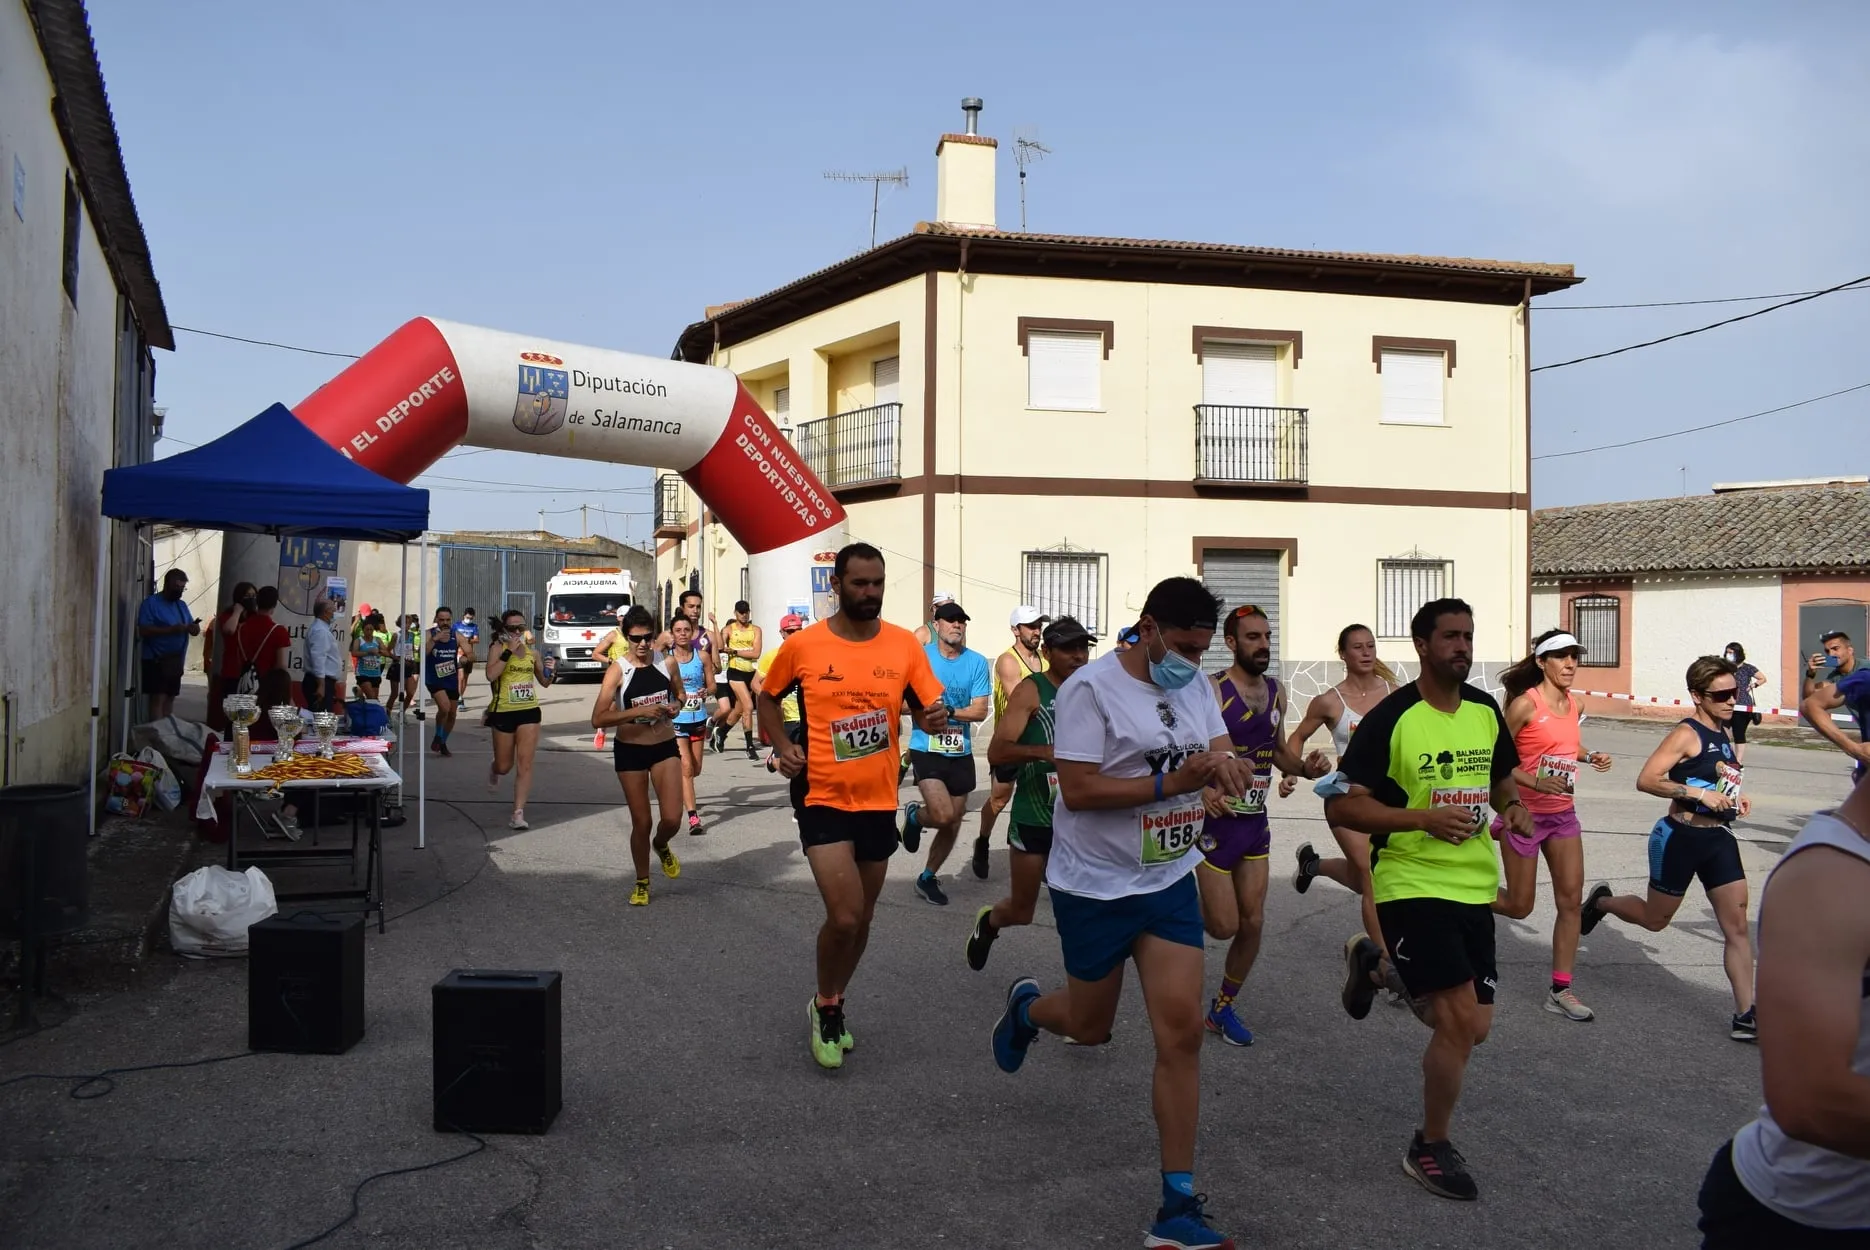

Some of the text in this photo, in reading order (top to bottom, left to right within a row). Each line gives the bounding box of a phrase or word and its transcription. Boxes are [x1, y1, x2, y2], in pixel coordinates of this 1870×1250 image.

[573, 369, 668, 397] Diputación
[350, 366, 456, 452] EL DEPORTE
[568, 409, 682, 435] de Salamanca
[743, 414, 833, 519] CON NUESTROS
[735, 432, 818, 527] DEPORTISTAS
[515, 690, 530, 698] 172
[831, 712, 888, 734] bedunia
[845, 726, 880, 749] 126
[938, 735, 959, 746] 186
[1431, 790, 1489, 805] bedunia
[1142, 806, 1205, 830] bedunia
[1156, 824, 1194, 851] 158
